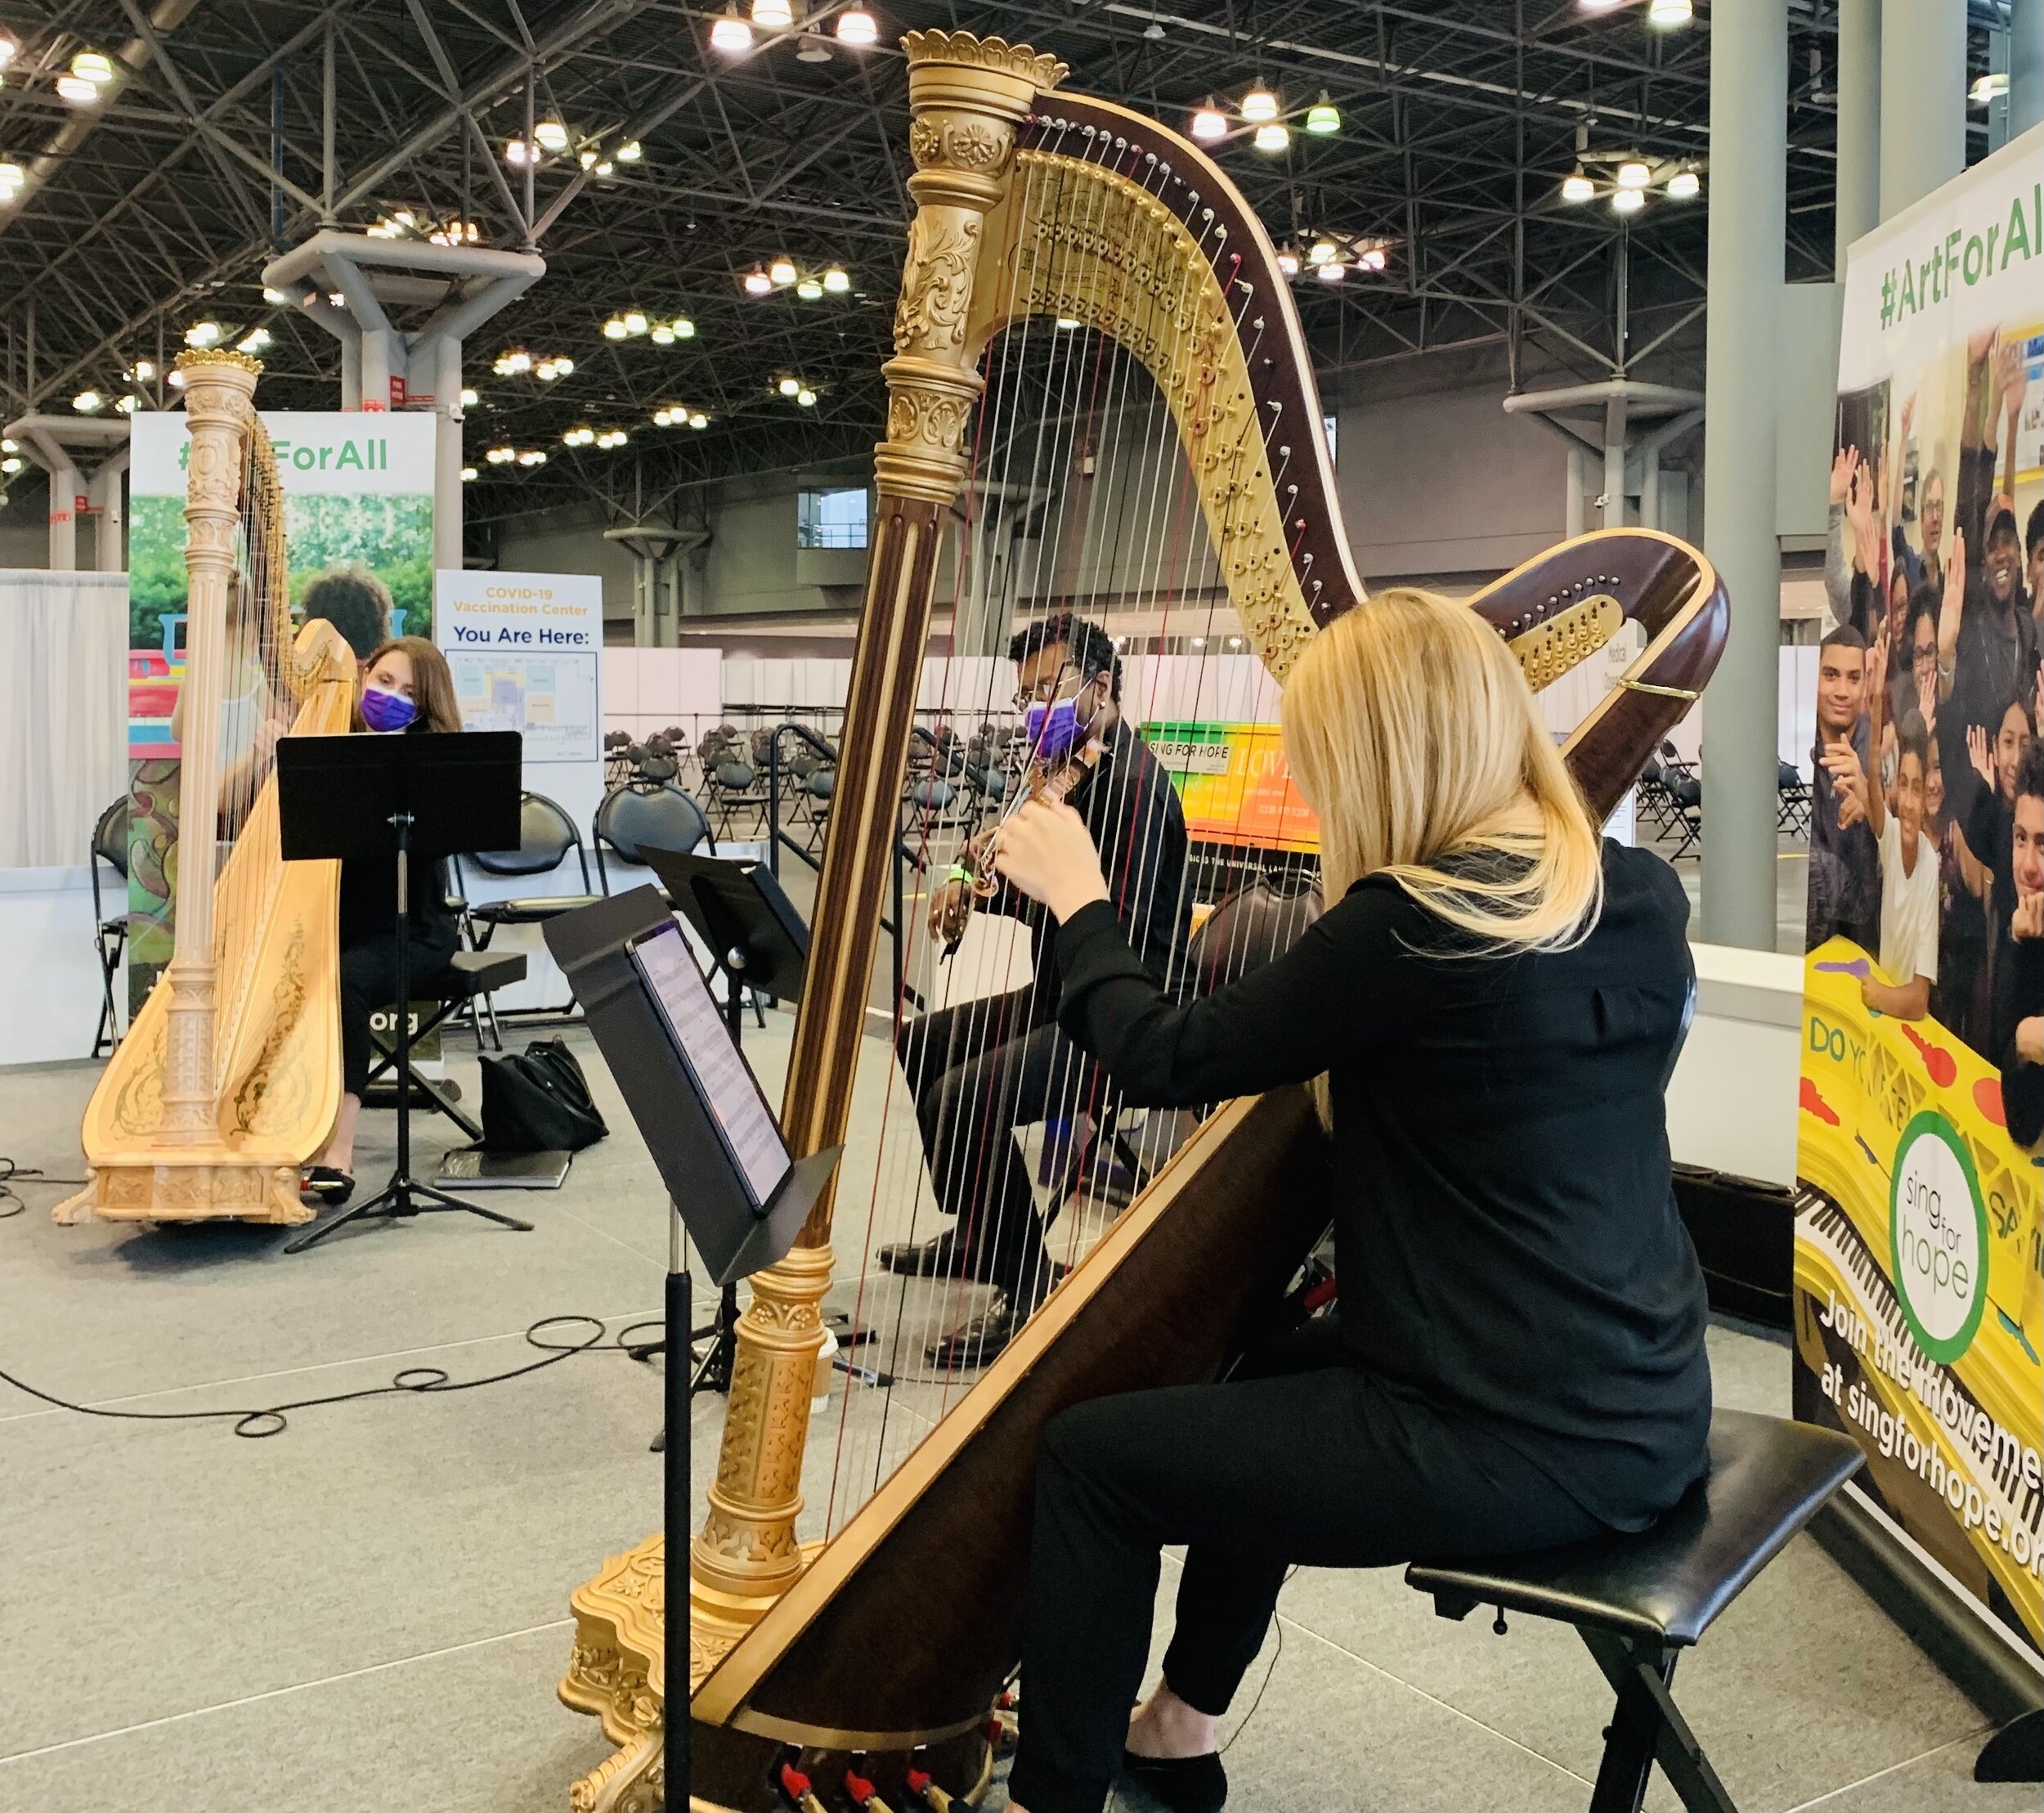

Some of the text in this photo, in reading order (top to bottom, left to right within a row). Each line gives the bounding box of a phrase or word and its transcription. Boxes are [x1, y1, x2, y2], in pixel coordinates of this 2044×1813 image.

[178, 438, 388, 470] #ForAll
[453, 601, 589, 616] Vaccination Center
[485, 587, 554, 599] COVID-19
[453, 626, 589, 644] You Are Here:
[1149, 743, 1229, 759] SING FOR HOPE
[1810, 1016, 1846, 1062] DO
[1906, 1169, 1942, 1229] sing
[1941, 1217, 1961, 1253] for
[1902, 1214, 1969, 1299] hope
[1819, 1290, 1868, 1358] Join
[1874, 1326, 1912, 1389] the
[1821, 1362, 1844, 1406] at
